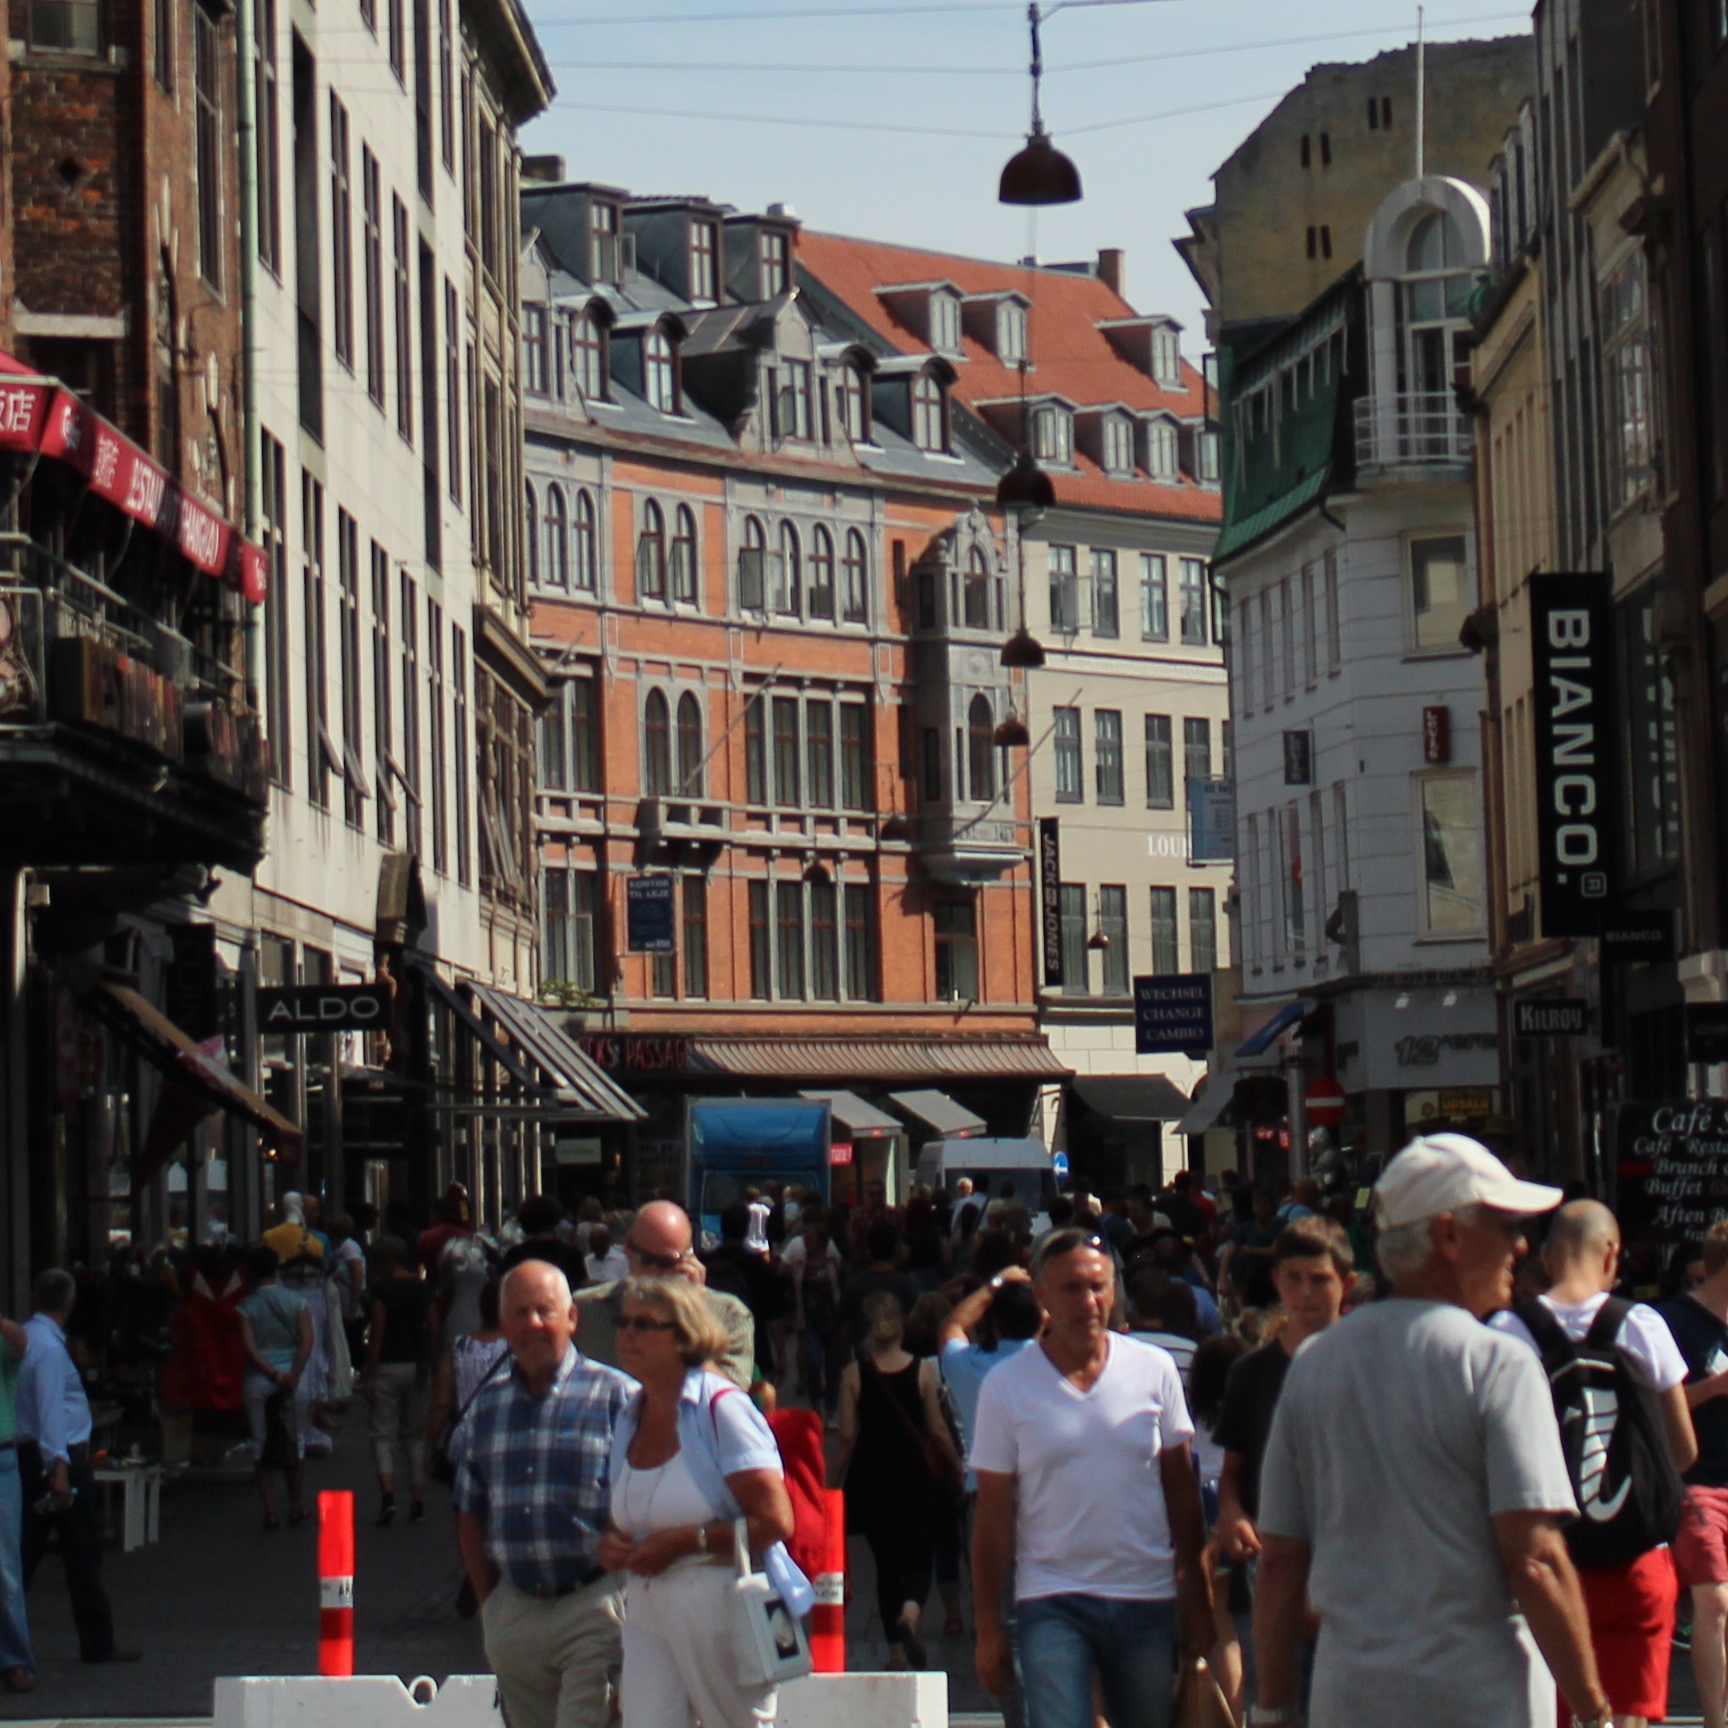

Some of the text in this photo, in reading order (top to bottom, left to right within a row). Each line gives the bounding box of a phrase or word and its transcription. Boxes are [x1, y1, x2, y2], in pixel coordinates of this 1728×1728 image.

[268, 995, 380, 1022] ALDO
[1142, 1006, 1204, 1020] CHANGE
[1520, 1004, 1583, 1031] KILROY
[1651, 1103, 1713, 1140] Café
[1632, 1135, 1671, 1158] Café
[1655, 1156, 1718, 1175] Brunch
[1644, 1176, 1702, 1201] Buffet
